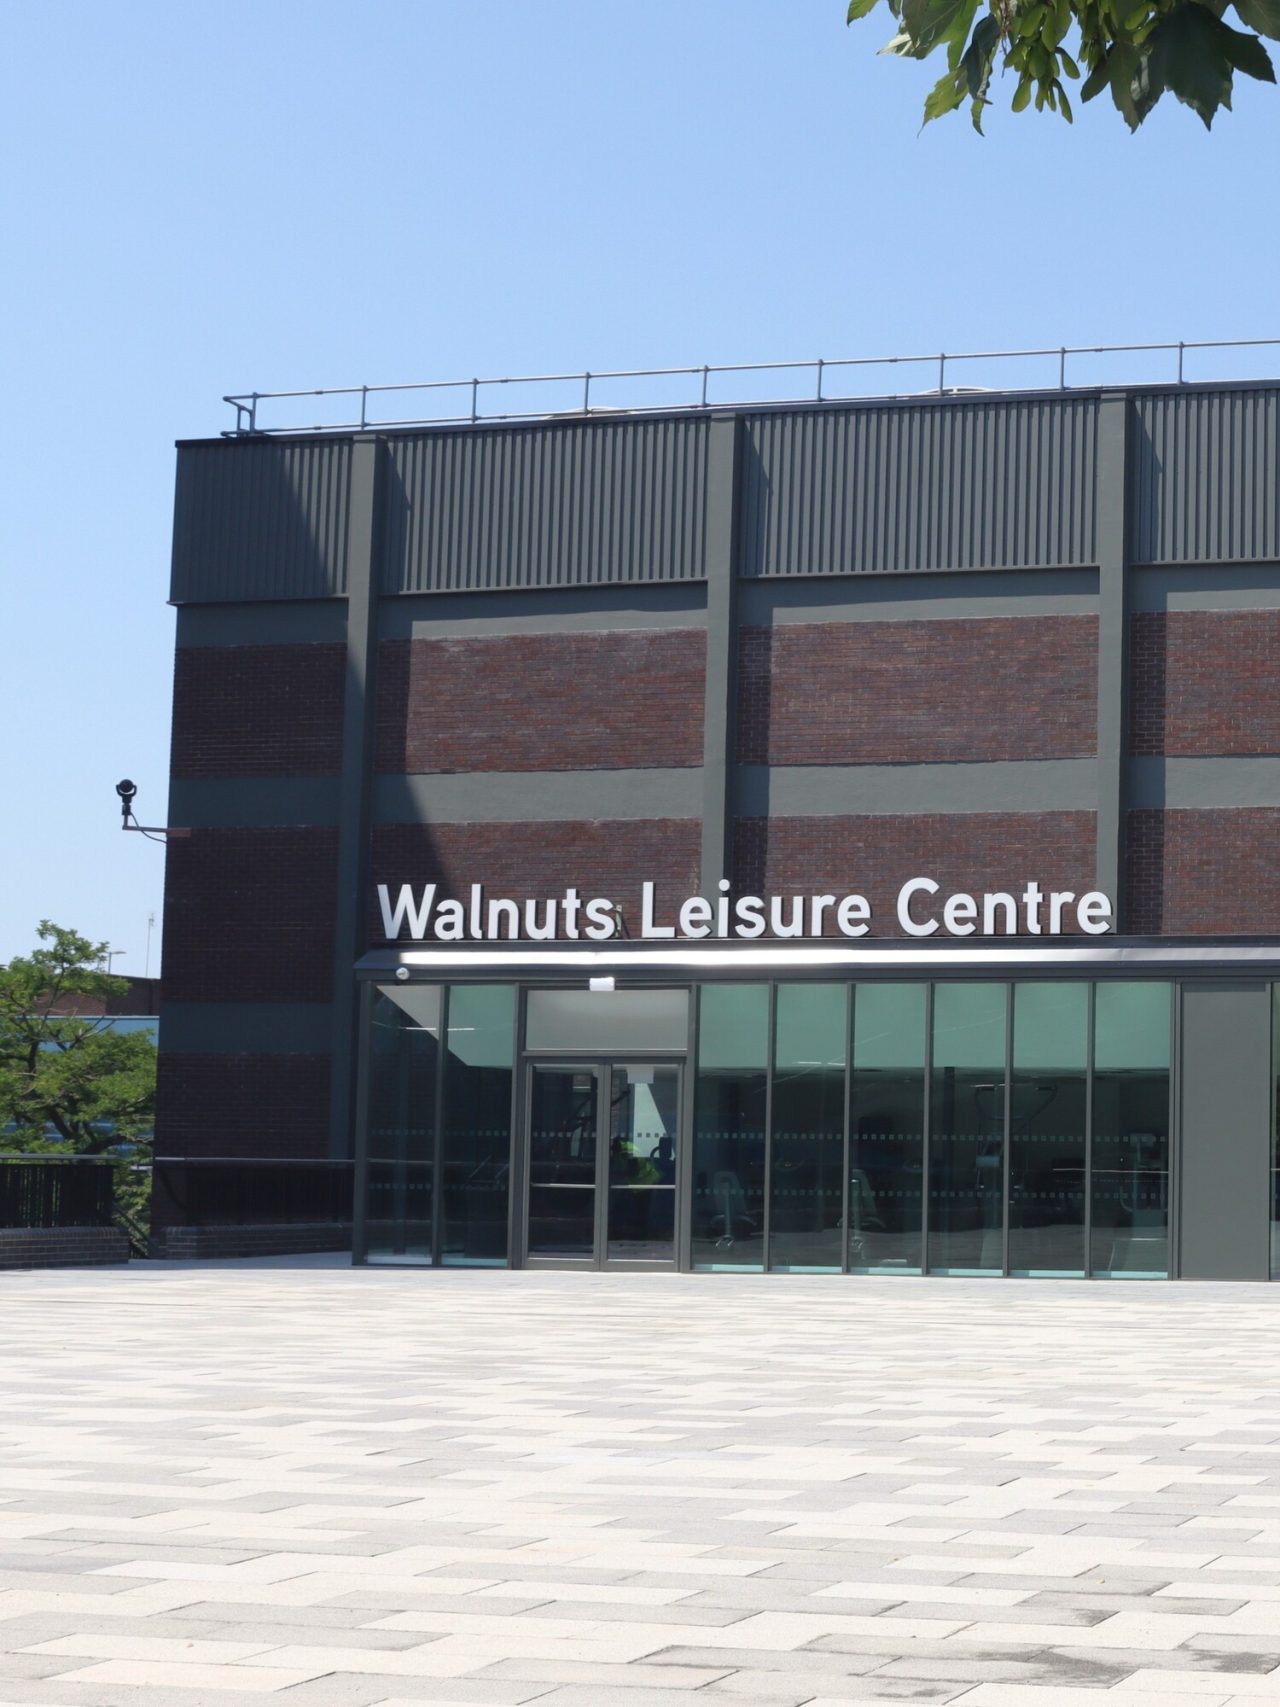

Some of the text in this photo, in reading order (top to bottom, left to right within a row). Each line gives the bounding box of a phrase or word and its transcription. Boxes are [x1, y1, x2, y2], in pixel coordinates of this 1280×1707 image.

[376, 875, 1113, 941] Walnuts Leisure Centre
